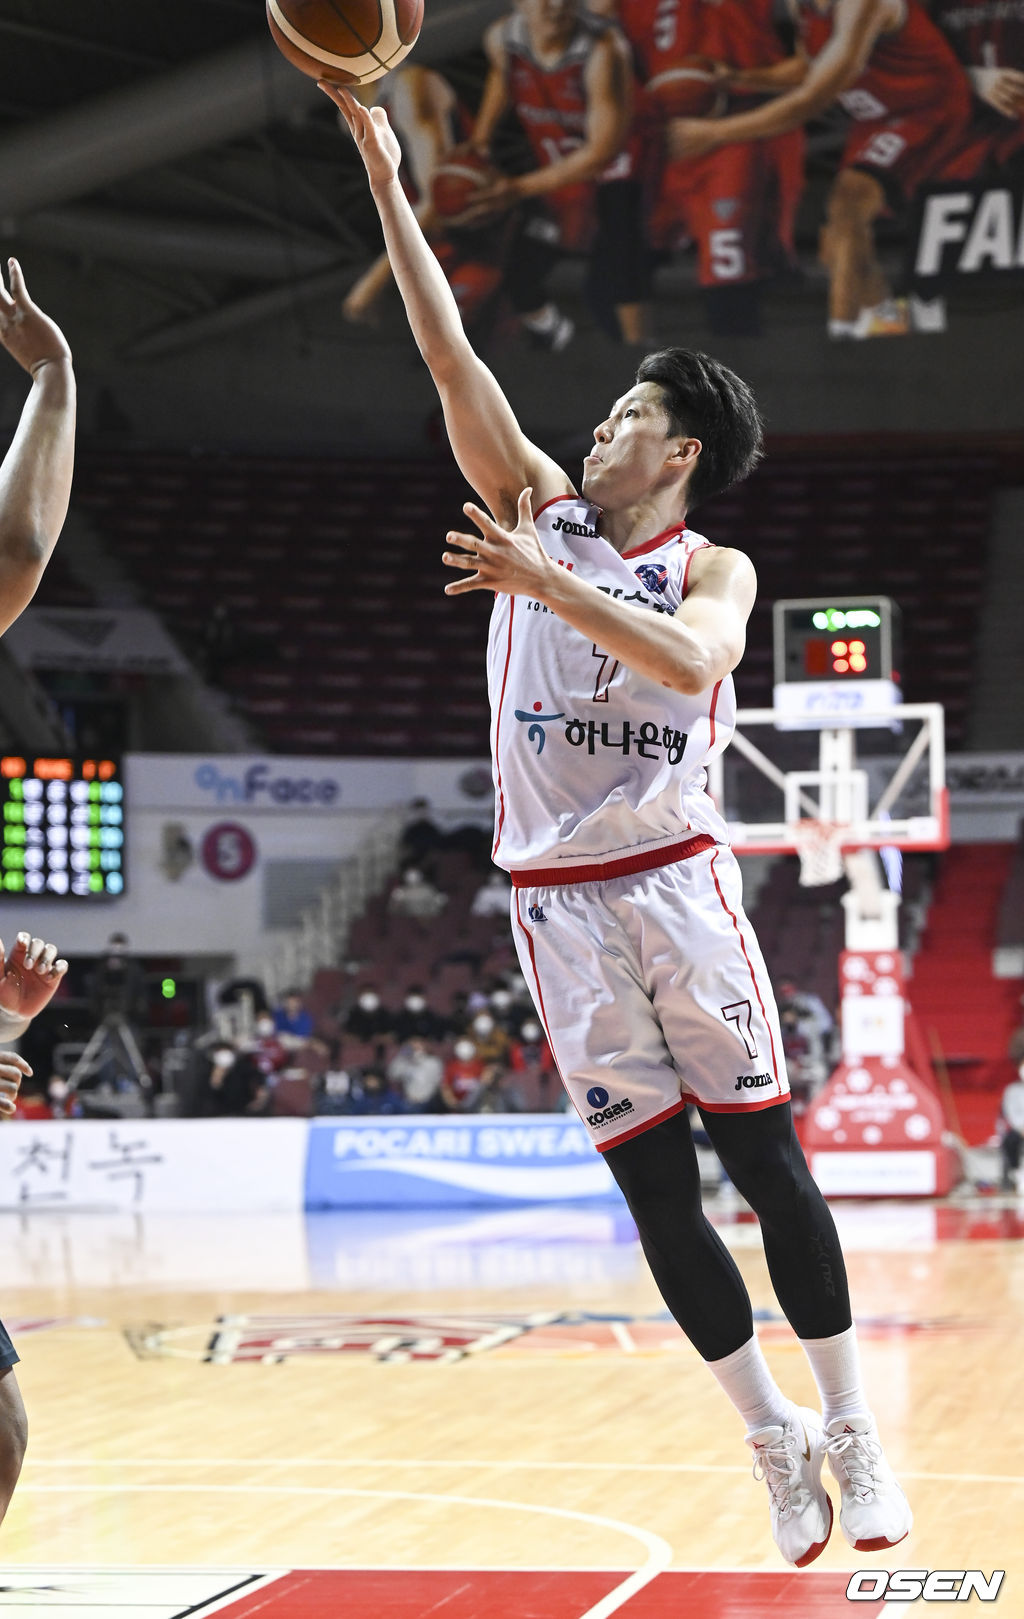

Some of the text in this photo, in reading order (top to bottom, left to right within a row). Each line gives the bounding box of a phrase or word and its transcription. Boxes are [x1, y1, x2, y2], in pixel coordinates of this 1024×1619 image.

[709, 229, 745, 279] 5
[914, 189, 1024, 276] FA
[565, 717, 688, 765] 하나은행
[721, 999, 758, 1060] 7
[334, 1128, 471, 1158] POCARI
